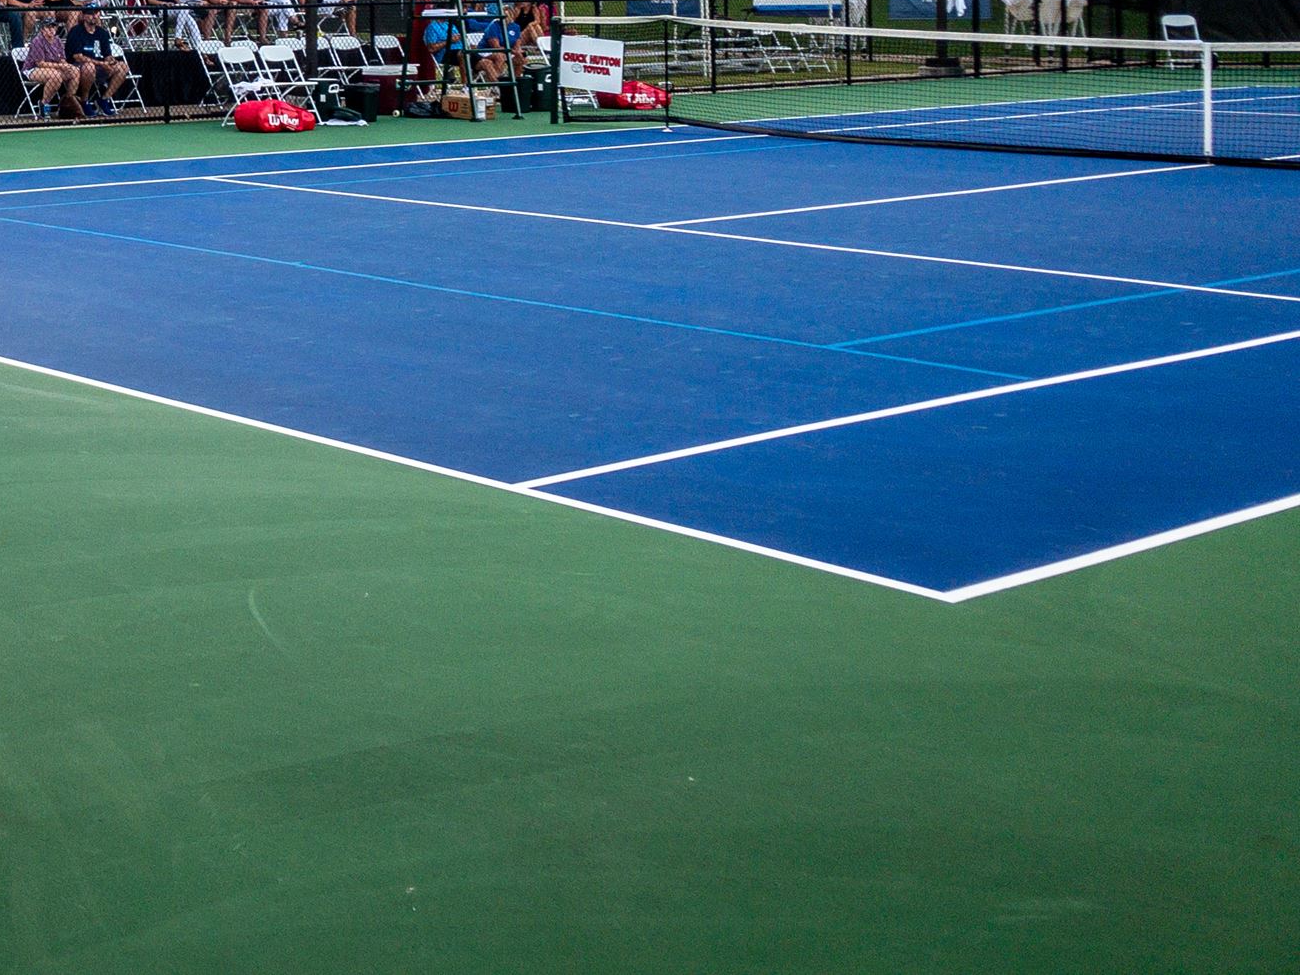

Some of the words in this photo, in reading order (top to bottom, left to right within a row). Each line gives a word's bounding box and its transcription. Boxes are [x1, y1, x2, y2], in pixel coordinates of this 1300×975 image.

[563, 52, 588, 64] CHUCK
[590, 54, 621, 68] HUTTON
[583, 64, 611, 76] TOYOTA
